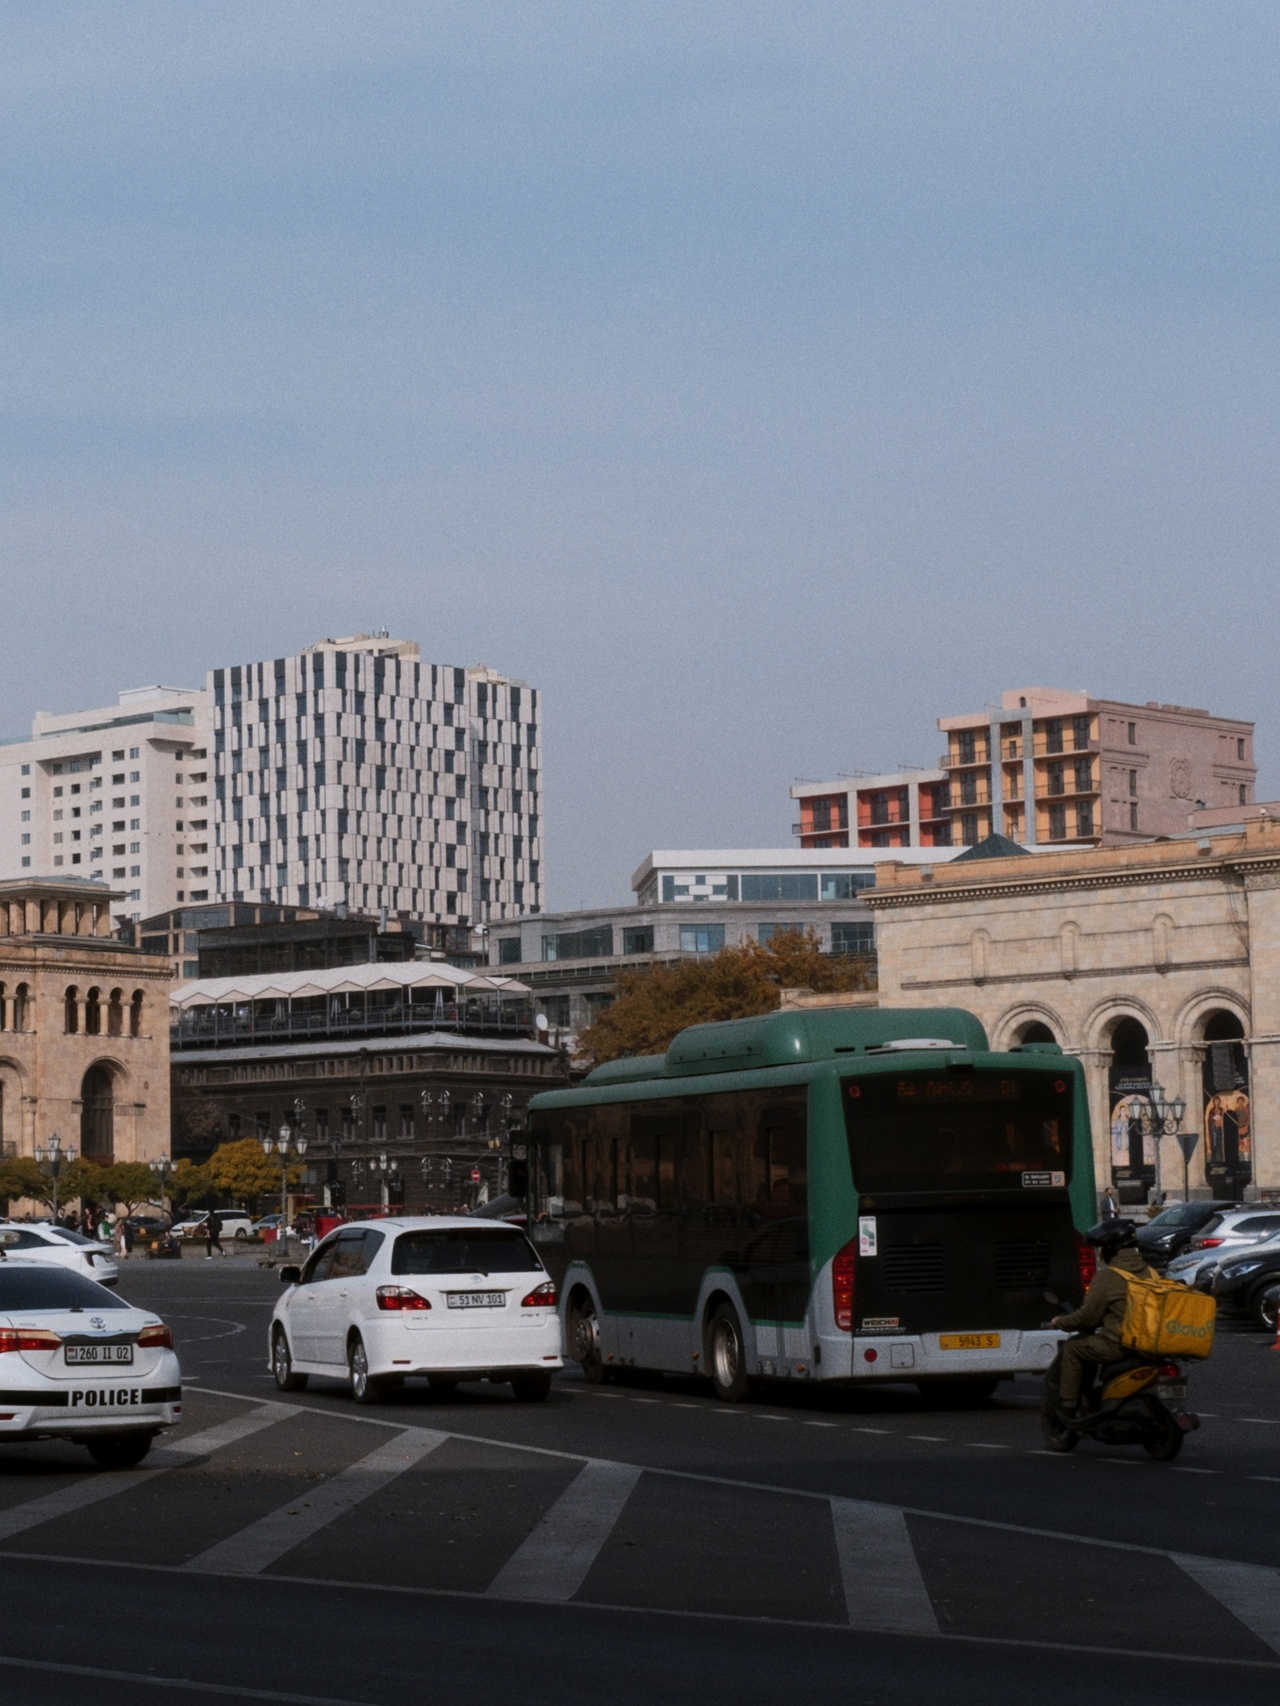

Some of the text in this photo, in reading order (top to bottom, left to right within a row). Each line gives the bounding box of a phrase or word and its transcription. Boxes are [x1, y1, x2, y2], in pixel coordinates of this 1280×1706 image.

[459, 1294, 503, 1305] 51 NV 101
[959, 1335, 994, 1347] 5943 S
[79, 1347, 98, 1360] 260
[116, 1346, 129, 1360] 02
[71, 1388, 139, 1407] POLICE
